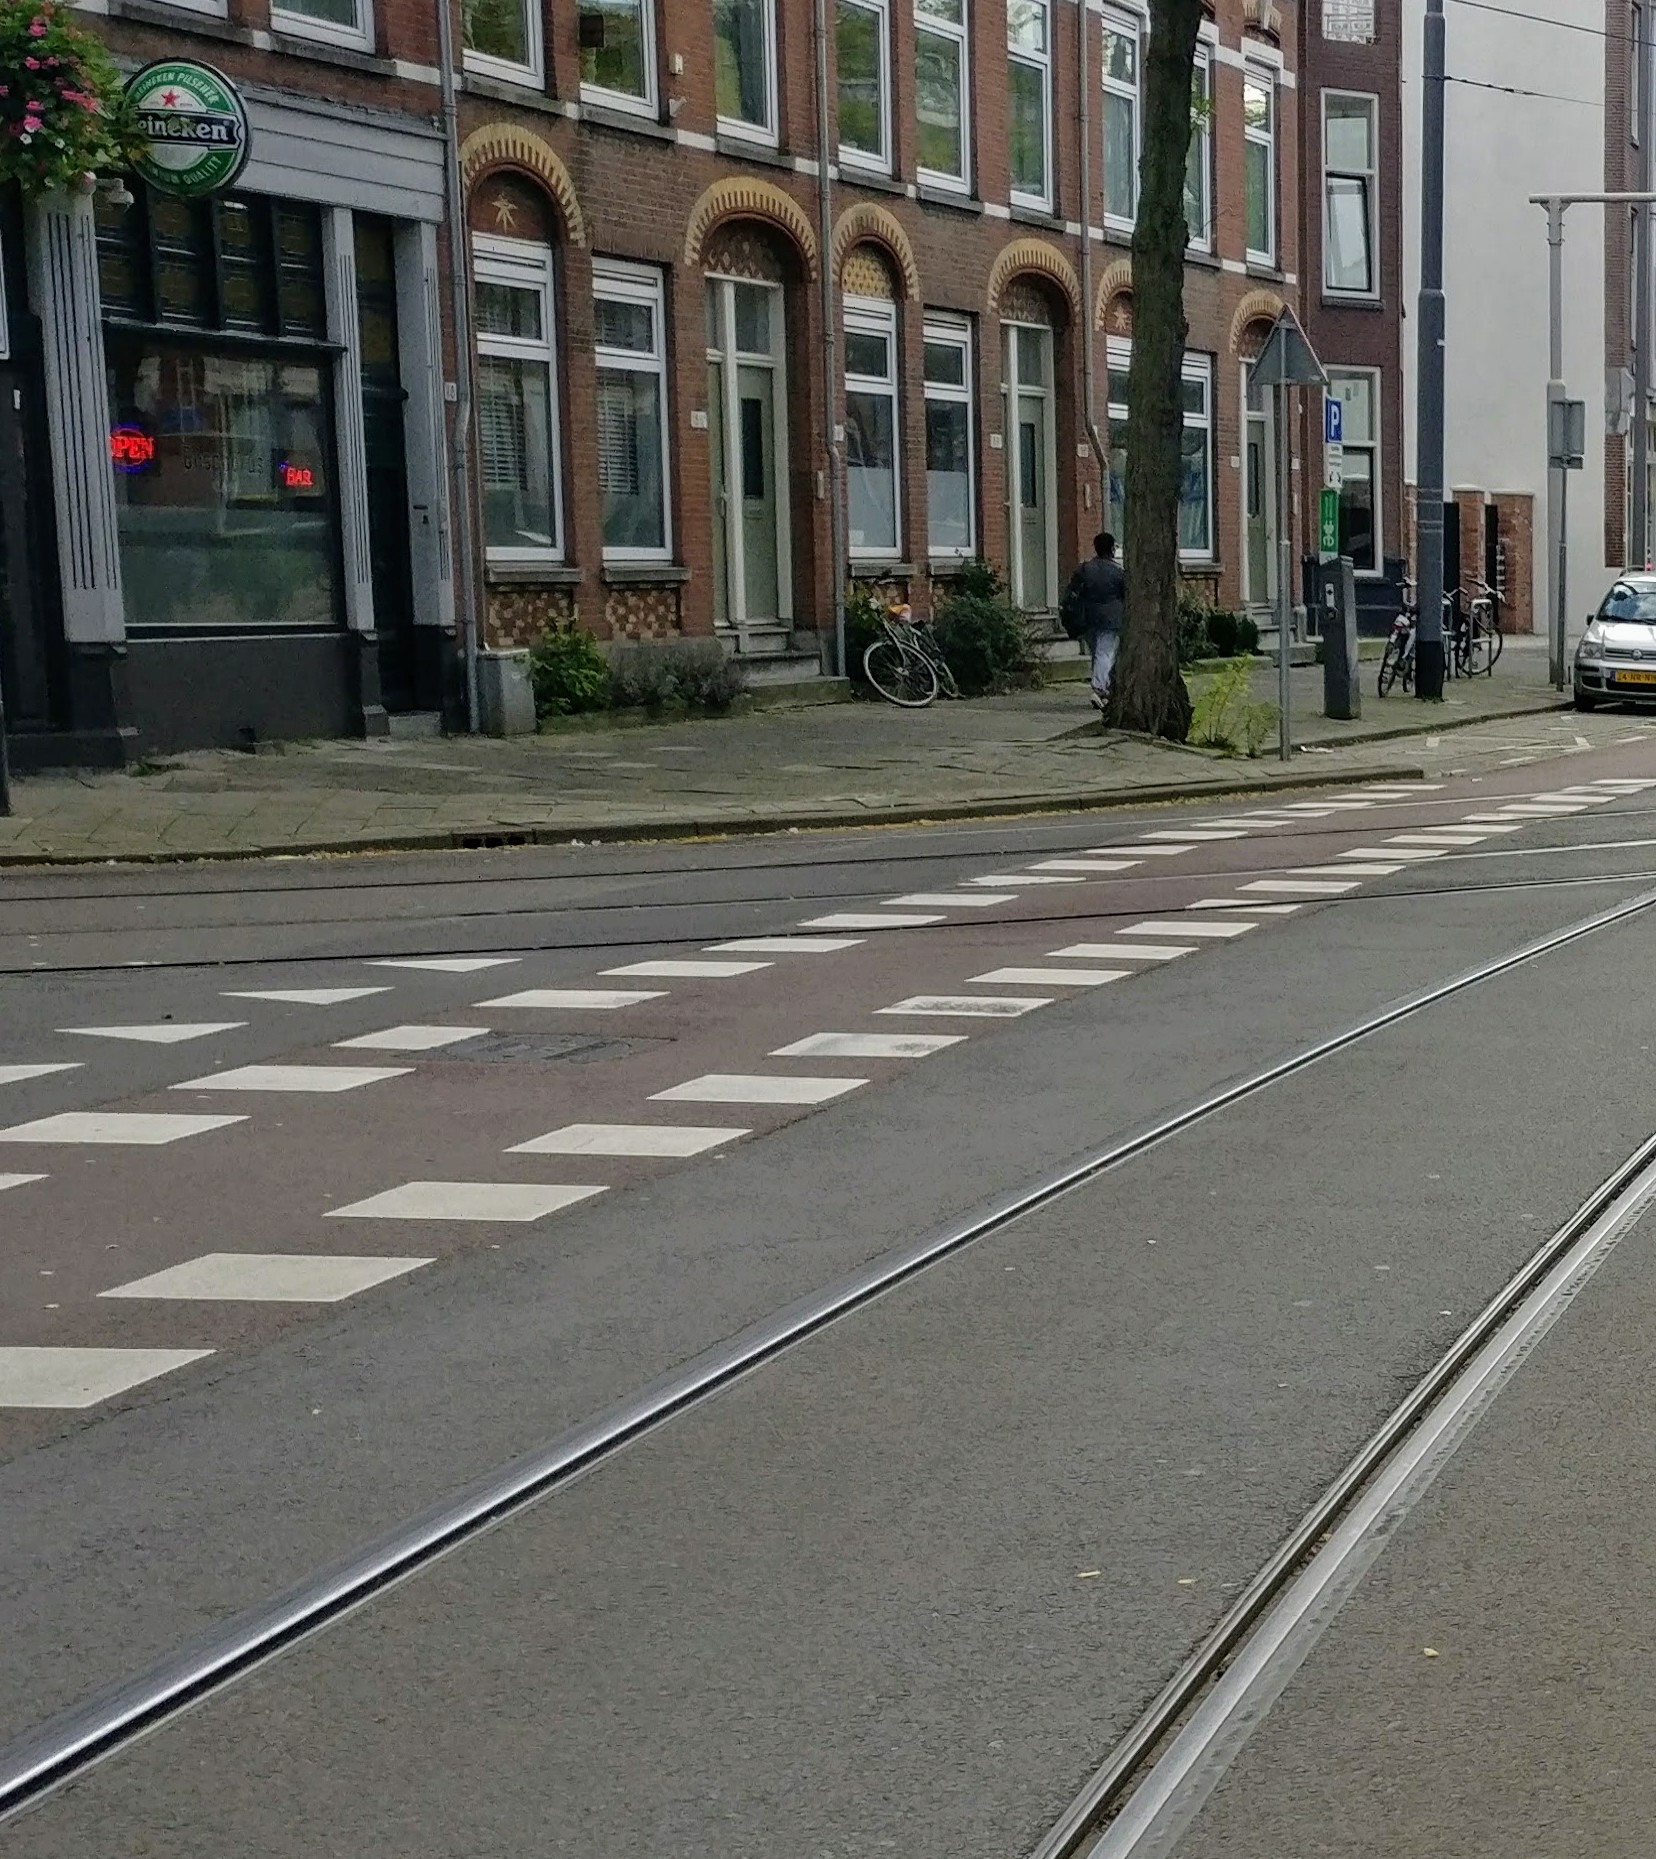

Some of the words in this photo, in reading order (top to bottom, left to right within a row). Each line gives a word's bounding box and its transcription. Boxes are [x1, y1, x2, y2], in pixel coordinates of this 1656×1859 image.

[137, 115, 228, 140] eineken
[183, 156, 222, 185] QUALITY
[1331, 404, 1339, 437] P
[286, 468, 313, 486] BAR
